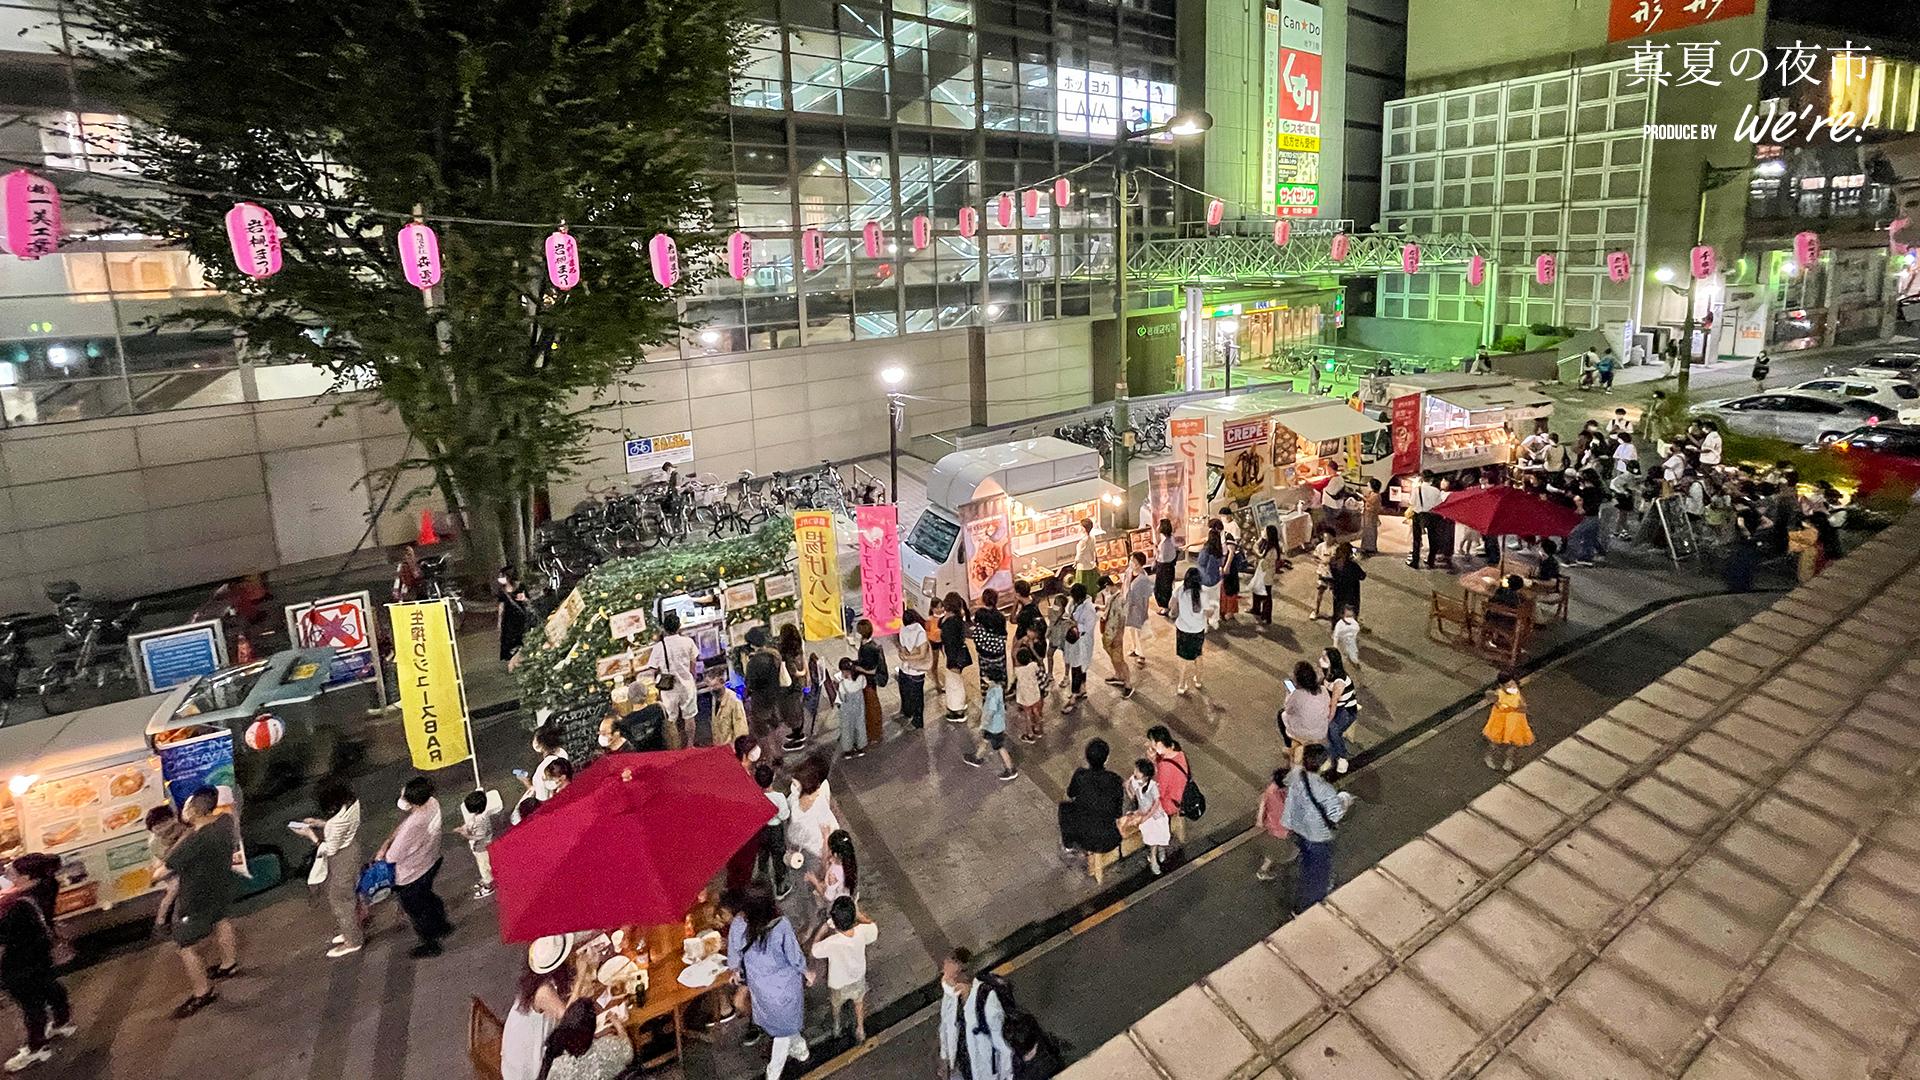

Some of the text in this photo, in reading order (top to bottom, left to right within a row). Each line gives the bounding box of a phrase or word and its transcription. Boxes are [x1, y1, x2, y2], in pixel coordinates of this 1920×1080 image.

[1064, 75, 1110, 95] ホッヨガ
[1282, 52, 1321, 123] くすり
[1064, 97, 1110, 126] LAVA
